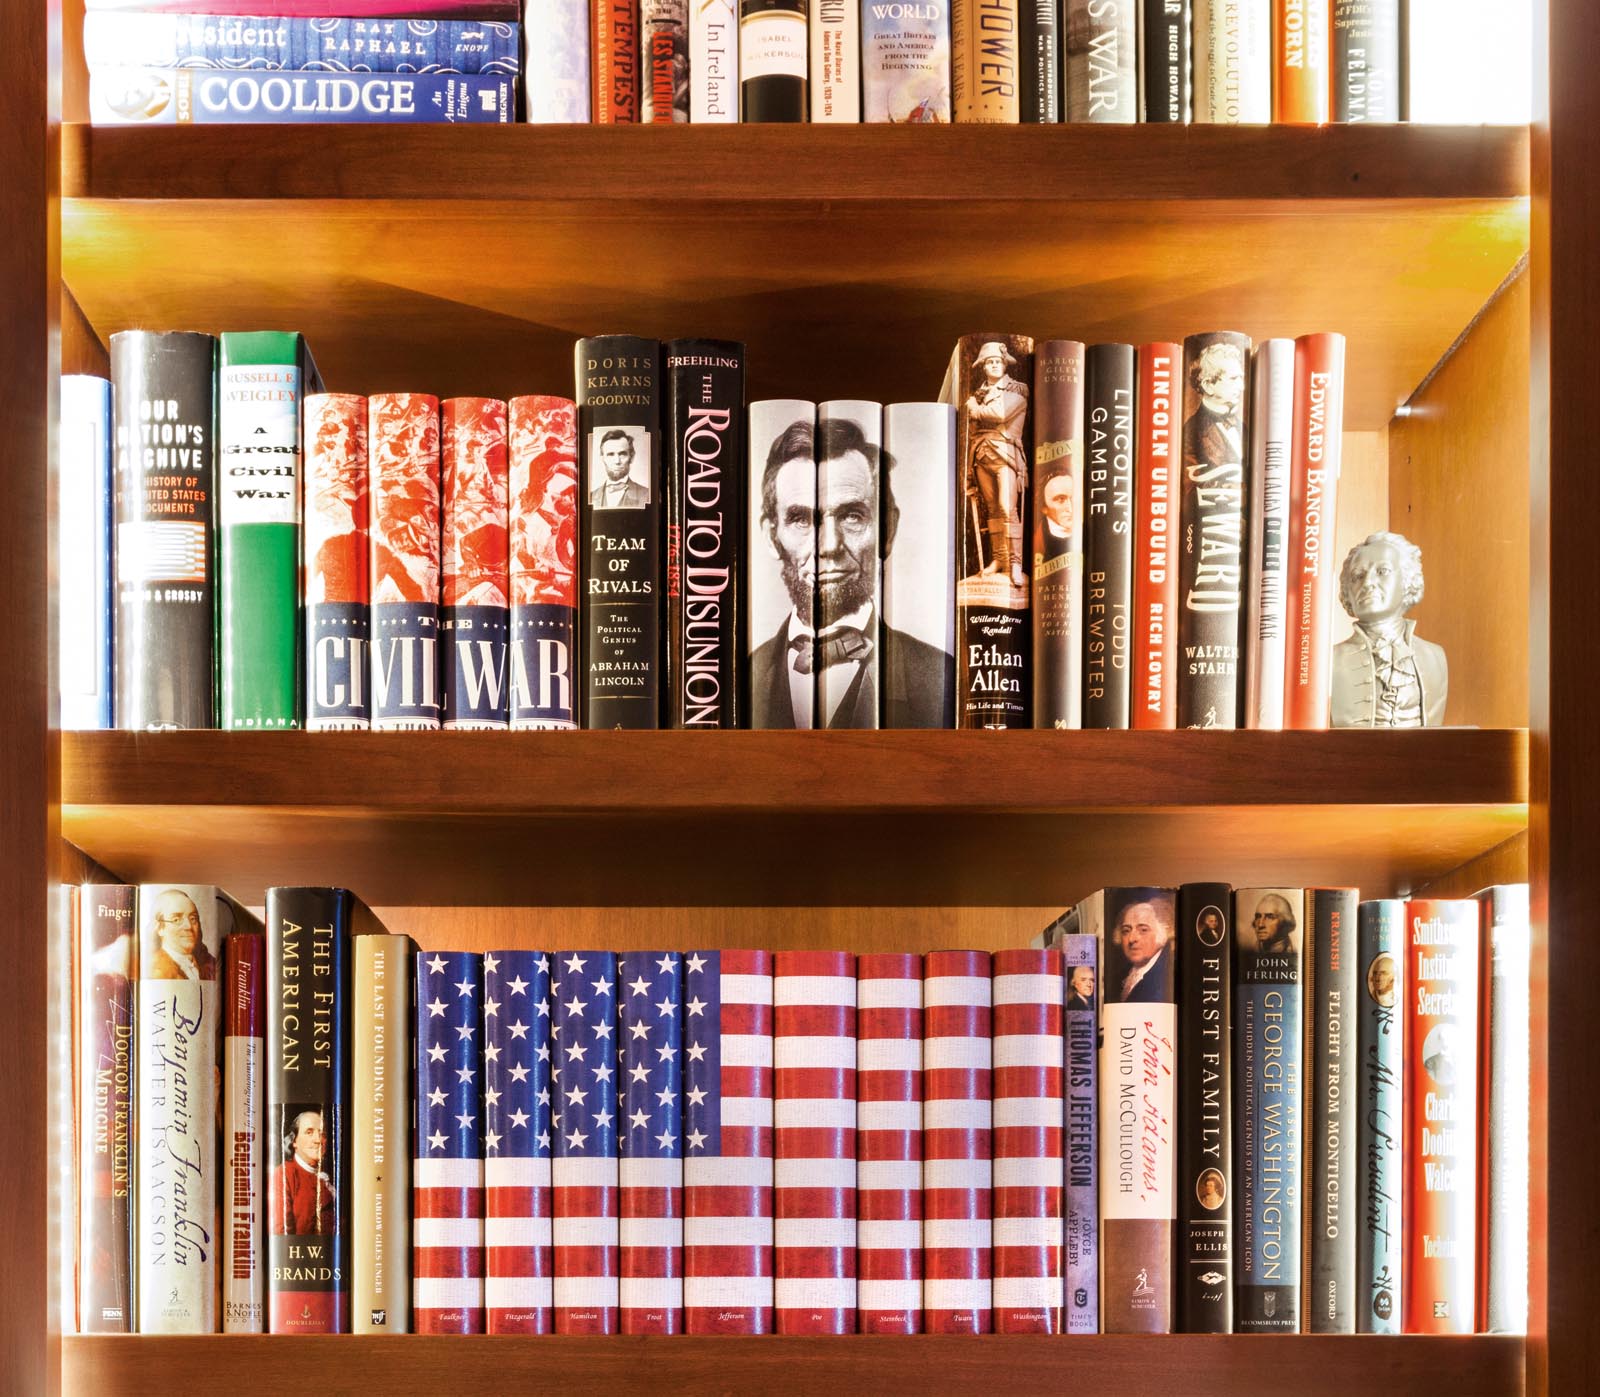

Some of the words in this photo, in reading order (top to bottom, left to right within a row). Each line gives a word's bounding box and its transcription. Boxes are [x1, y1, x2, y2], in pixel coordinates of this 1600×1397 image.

[354, 22, 396, 34] RAY
[871, 2, 939, 20] WORLD
[324, 37, 427, 55] RAPHAEL
[454, 43, 489, 53] KNOPF
[652, 31, 673, 58] LES
[707, 24, 726, 42] In
[874, 32, 901, 40] GREAT
[1168, 25, 1180, 62] HUGH
[707, 47, 726, 116] Ireland
[881, 62, 933, 71] BEGINNING
[1088, 27, 1118, 117] WAR
[200, 76, 416, 113] COOLIDGE
[431, 91, 443, 107] An
[444, 78, 456, 123] American
[457, 82, 469, 118] Enigma
[1168, 66, 1180, 121] HOWARD
[587, 358, 652, 370] DORIS
[667, 355, 739, 369] FREEHLING
[227, 390, 297, 402] WEIGLEY
[587, 376, 652, 388] KEARNS
[587, 395, 651, 406] GOODWIN
[702, 373, 713, 404] THE
[140, 400, 178, 420] OUR
[1152, 356, 1171, 458] LINCOLN
[1307, 370, 1331, 462] EDWARD
[226, 446, 302, 456] Great
[685, 405, 731, 509] ROAD
[1090, 406, 1109, 516] GAMBLE
[1113, 388, 1131, 535] LINCOLN'S
[1264, 440, 1285, 472] TRUE
[185, 476, 198, 487] OF
[229, 467, 296, 477] Civil
[171, 490, 206, 501] STATES
[232, 489, 290, 499] War
[1263, 476, 1284, 513] TALES
[686, 511, 723, 559] TO
[1149, 467, 1169, 585] UNBOUND
[1186, 462, 1244, 615] SEWARD
[1265, 519, 1282, 536] OF
[1303, 468, 1328, 577] BANCROFT
[608, 559, 630, 572] OF
[668, 523, 681, 598] 1776-1854
[1264, 542, 1282, 569] THE
[164, 590, 203, 602] CROSBY
[1261, 575, 1280, 609] CIVIL
[1301, 581, 1313, 624] THOMAS
[418, 616, 473, 630] THE
[970, 615, 1000, 624] Willard
[1000, 615, 1022, 624] Sterne
[981, 626, 1012, 636] Randall
[1088, 571, 1106, 699] BREWSTER
[1112, 601, 1126, 669] TODD
[1149, 602, 1164, 645] RICH
[1259, 612, 1279, 642] WAR
[685, 563, 730, 726] DISUNION
[969, 644, 1023, 667] Ethan
[1185, 646, 1239, 659] WALTER
[1300, 635, 1312, 686] SCHAEPER
[315, 637, 445, 710] CIVIL
[456, 638, 574, 711] WAR
[590, 662, 650, 672] ABRAHAM
[595, 677, 645, 686] LINCOLN
[970, 669, 1020, 692] Allen
[1147, 650, 1163, 713] LOWRY
[966, 703, 977, 711] His
[978, 702, 992, 710] Life
[1005, 702, 1024, 711] Times
[98, 904, 133, 920] Finger
[313, 923, 333, 977] THE
[1330, 911, 1341, 971] KRANISH
[374, 950, 385, 980] THE
[1255, 958, 1289, 968] JOHN
[236, 959, 252, 1010] Franklin
[282, 918, 302, 1072] AMERICAN
[373, 984, 385, 1020] LAST
[1202, 958, 1220, 1041] FIRST
[1246, 1000, 1255, 1020] THE
[1328, 990, 1342, 1057] FLIGHT
[313, 991, 334, 1069] FIRST
[1246, 1023, 1255, 1063] HIDDEN
[1263, 991, 1284, 1094] GEORGE
[114, 1024, 132, 1094] DOCTOR
[151, 1000, 167, 1110] WALTER
[162, 985, 204, 1134] Benjamin
[244, 1043, 257, 1058] The
[373, 1025, 385, 1103] FOUNDING
[1070, 1019, 1092, 1088] THOMAS
[1119, 1026, 1137, 1075] DAVID
[1142, 1020, 1173, 1086] John
[243, 1060, 256, 1117] Autobiography
[1246, 1065, 1255, 1117] POLITICAL
[1286, 1062, 1297, 1096] THE
[1328, 1063, 1341, 1114] FROM
[1367, 1046, 1394, 1101] Mr.
[94, 1068, 113, 1154] MEDICINE
[243, 1118, 256, 1131] of
[1202, 1052, 1221, 1160] FAMILY
[114, 1099, 131, 1197] FRANKLIN'S
[373, 1107, 385, 1165] FATHER
[1070, 1094, 1093, 1188] JEFFERSON
[1246, 1120, 1255, 1157] GENIUS
[1286, 1105, 1297, 1176] ASCENT
[231, 1131, 256, 1207] Benjamin
[1246, 1159, 1254, 1172] OF
[1246, 1176, 1254, 1190] AN
[1327, 1120, 1341, 1239] MONTICELLO
[1366, 1110, 1394, 1246] President
[151, 1125, 167, 1267] ISAACSON
[165, 1125, 210, 1264] Franklin
[1262, 1102, 1284, 1280] WASHINGTON
[1286, 1186, 1297, 1209] OF
[375, 1193, 384, 1230] HARLOW
[1245, 1192, 1254, 1243] AMERICAN
[232, 1212, 256, 1279] Franklin
[288, 1245, 305, 1259] H.
[307, 1246, 325, 1259] W.
[374, 1233, 384, 1261] GILES
[1069, 1210, 1080, 1268] APPLEBY
[1082, 1217, 1092, 1256] JOYCE
[1195, 1243, 1229, 1251] ELLIS
[272, 1267, 342, 1281] BRANDS
[1245, 1247, 1254, 1273] ICON
[374, 1263, 384, 1295] UNGER
[226, 1301, 261, 1309] BARNES
[504, 1312, 536, 1322] Fitzgerald
[718, 1312, 745, 1322] Jefferson
[879, 1314, 908, 1322] Steinbeck
[1012, 1313, 1048, 1322] Washington
[1328, 1279, 1338, 1320] OXFORD
